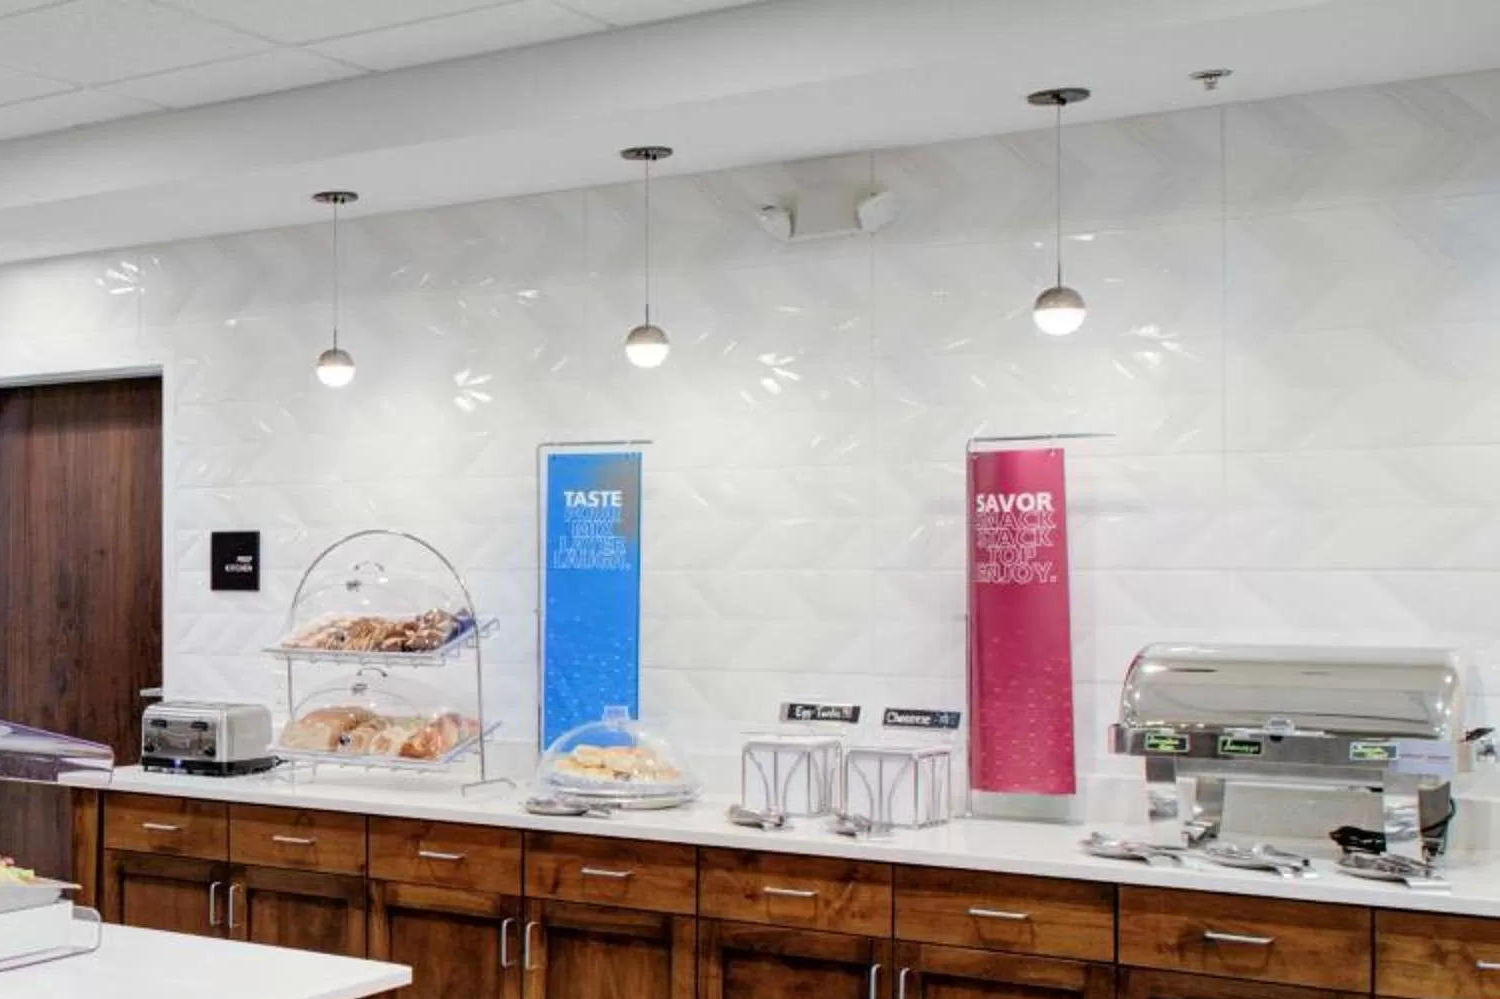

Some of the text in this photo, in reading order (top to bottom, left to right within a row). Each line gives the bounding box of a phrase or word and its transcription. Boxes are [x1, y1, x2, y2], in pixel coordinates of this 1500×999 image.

[563, 490, 623, 508] TASTE
[976, 492, 1055, 512] SAVOR
[987, 545, 1037, 565] TOP
[973, 561, 1057, 585] ENJOY.
